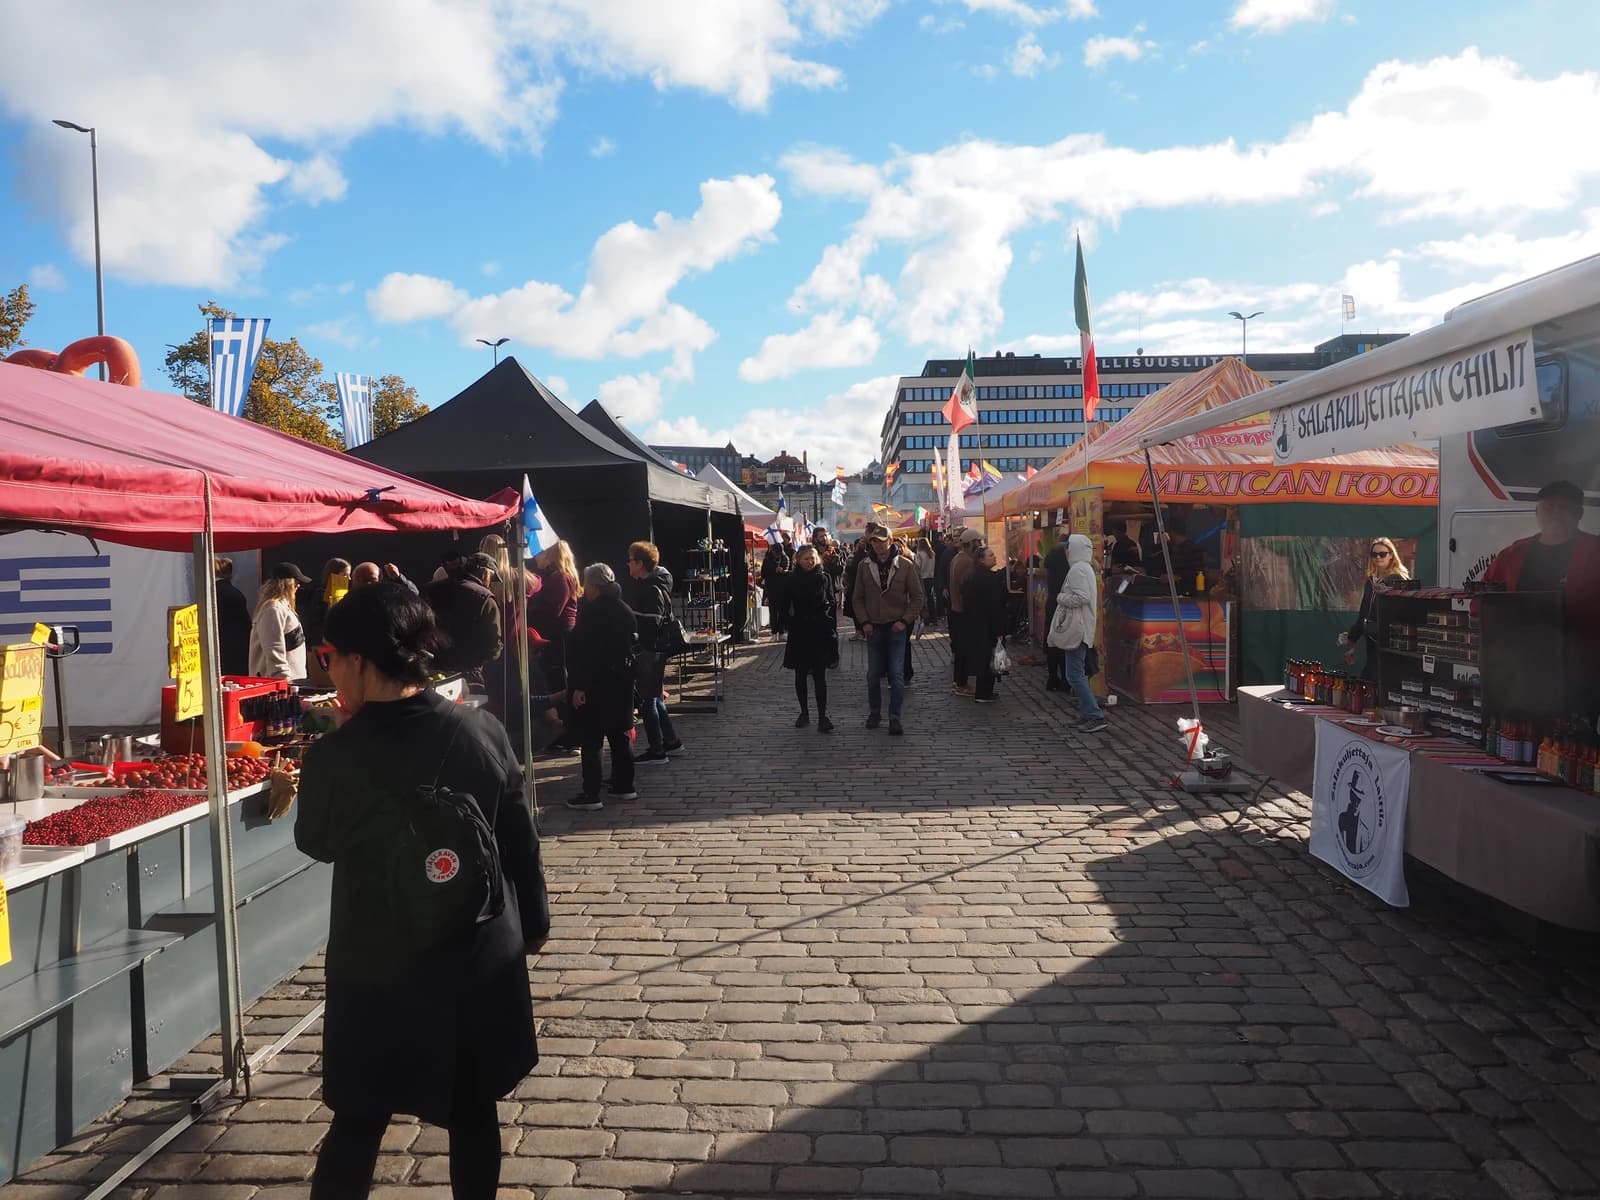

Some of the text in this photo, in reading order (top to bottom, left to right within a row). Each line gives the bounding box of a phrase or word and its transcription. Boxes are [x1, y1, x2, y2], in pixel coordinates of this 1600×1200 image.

[1063, 356, 1244, 369] TELLISUUSLIIT
[1298, 340, 1528, 439] SALAKULJETTAJAN CHILIT
[1136, 469, 1330, 496] MEXICAN
